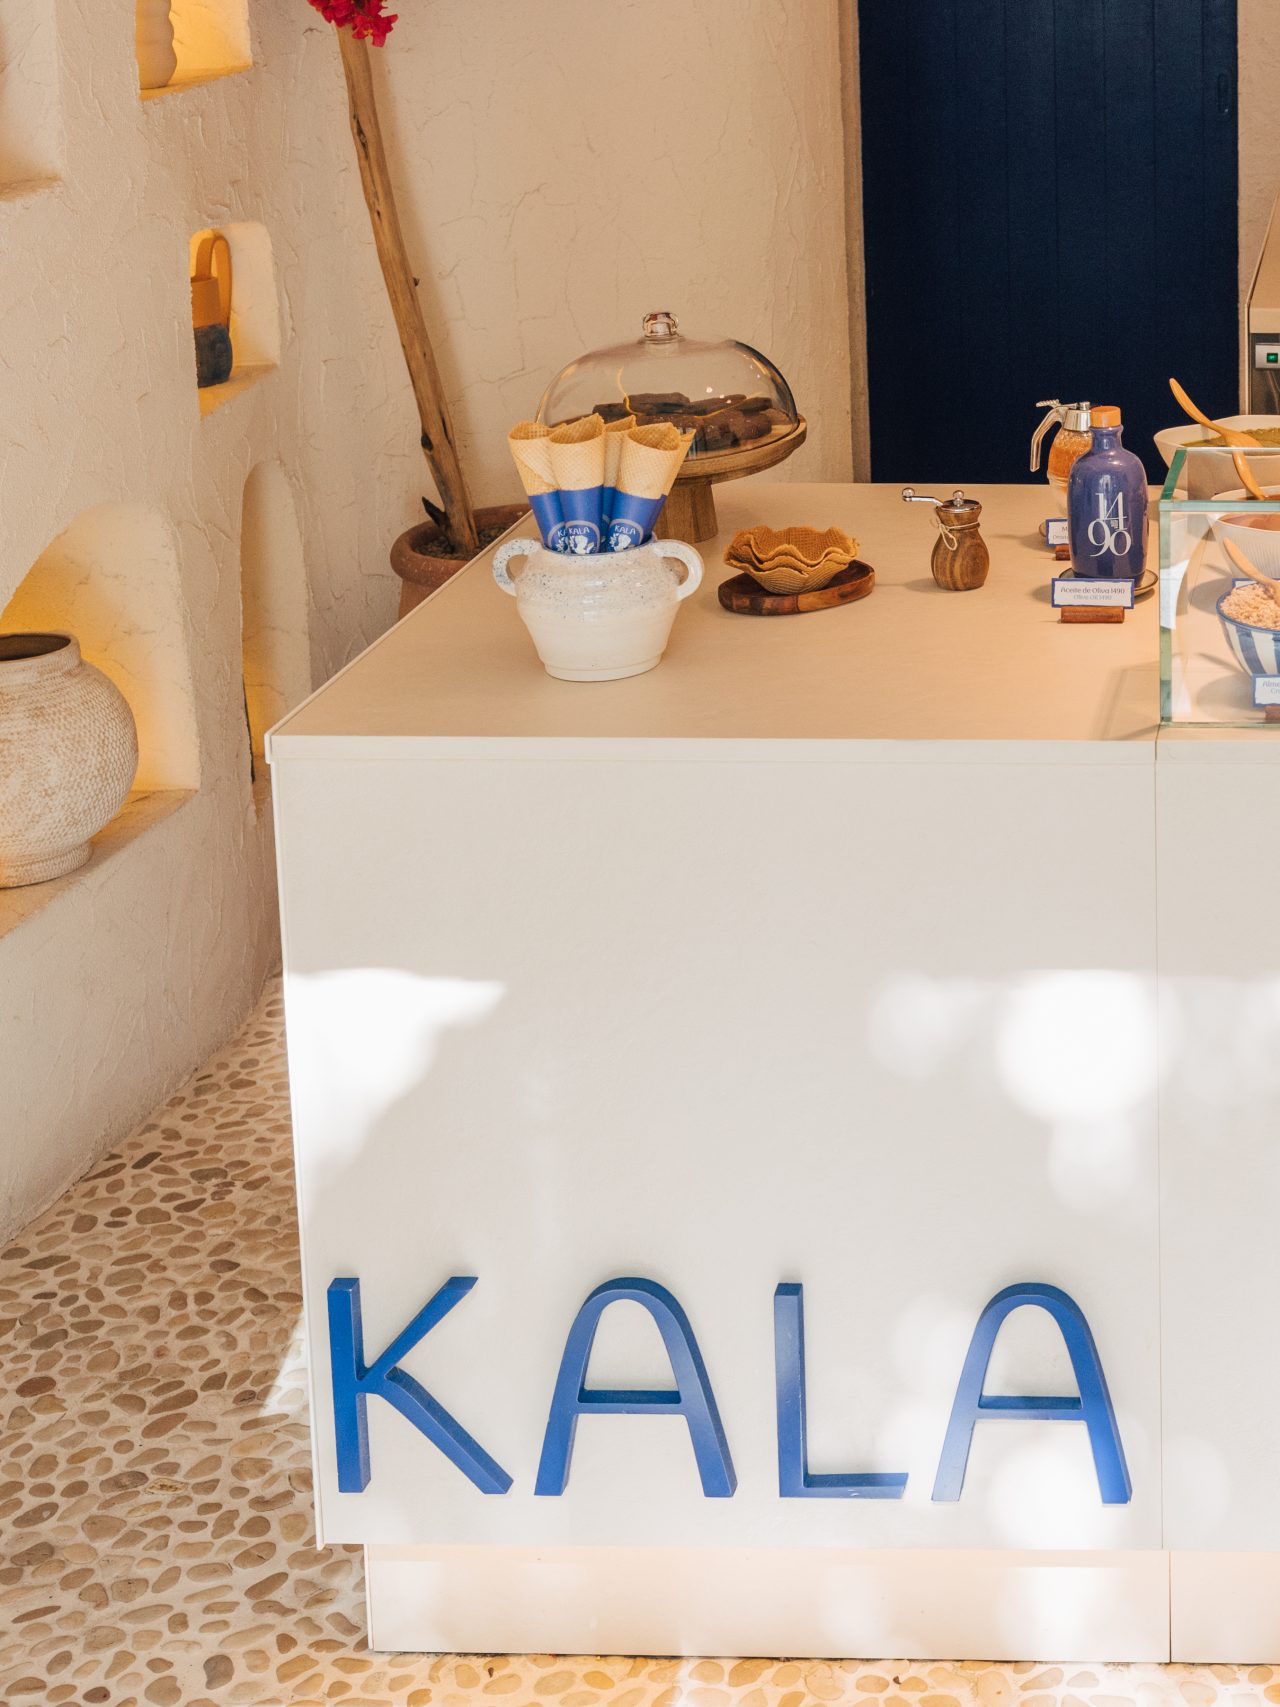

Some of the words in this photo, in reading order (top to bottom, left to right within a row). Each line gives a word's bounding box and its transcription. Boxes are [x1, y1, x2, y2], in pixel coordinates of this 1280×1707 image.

[568, 526, 590, 535] KALA
[614, 525, 636, 535] KALA
[327, 1276, 1132, 1504] KALA
